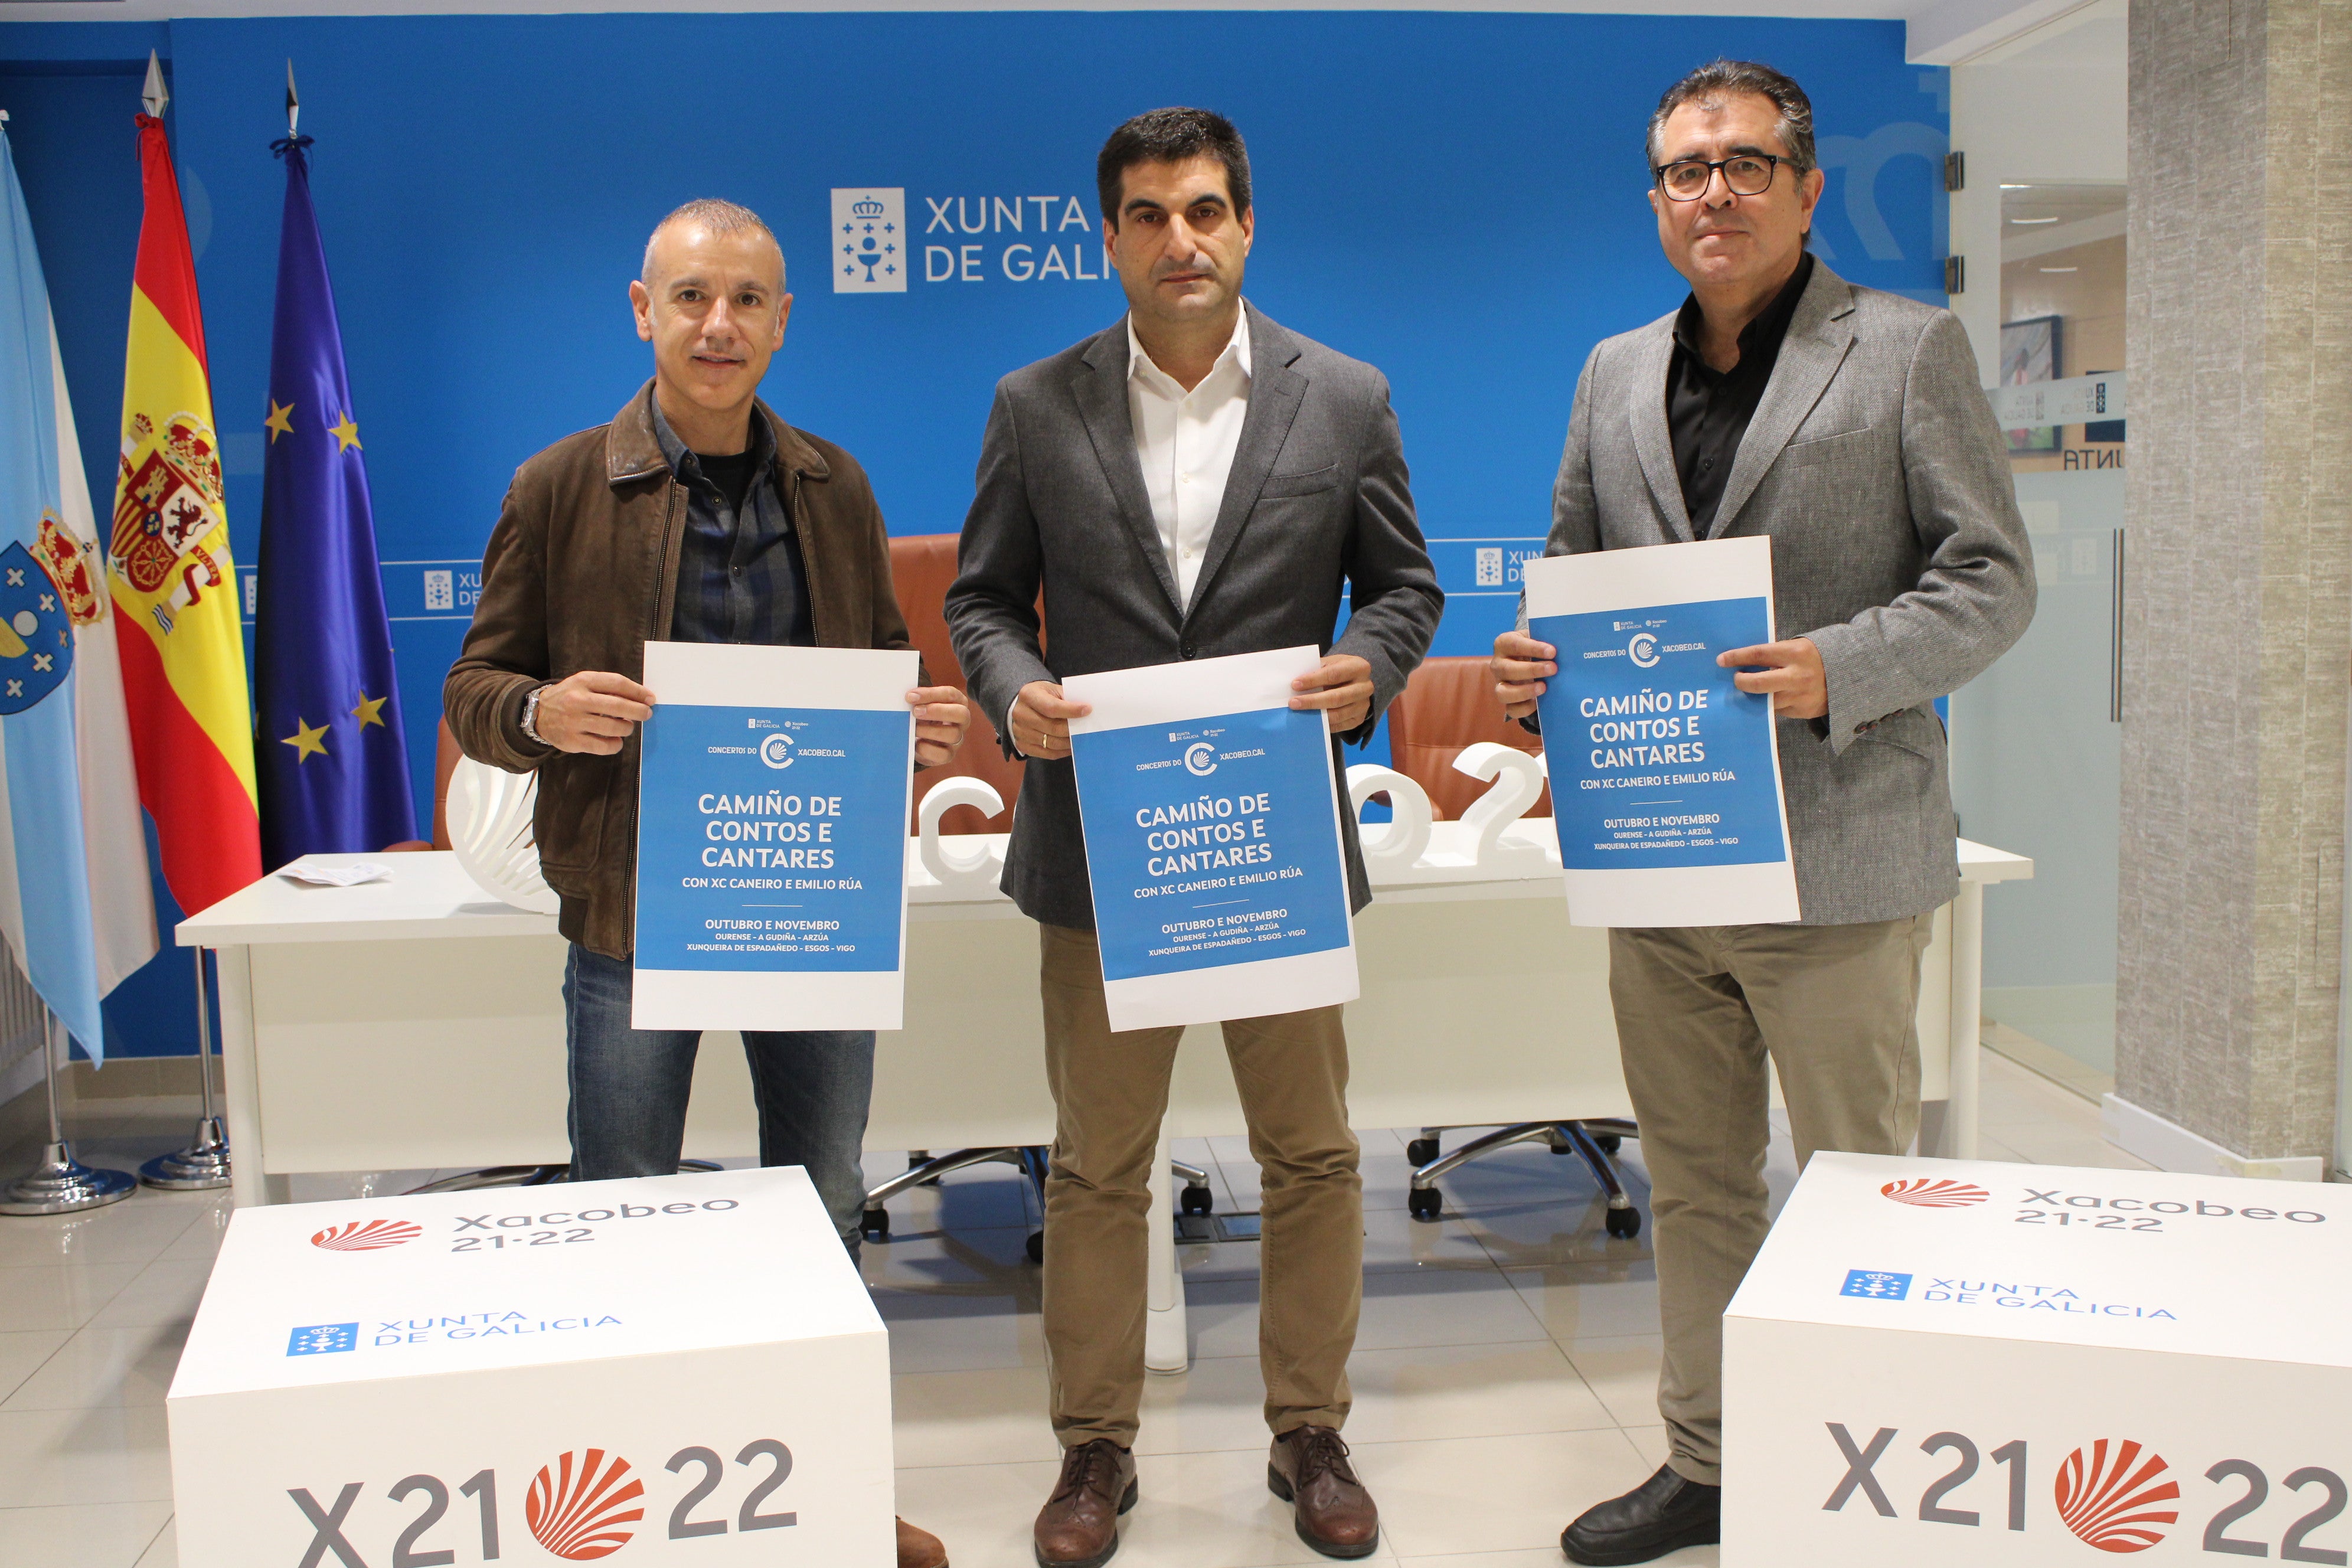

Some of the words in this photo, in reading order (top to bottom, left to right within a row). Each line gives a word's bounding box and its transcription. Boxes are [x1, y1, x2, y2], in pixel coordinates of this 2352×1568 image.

[926, 196, 1090, 234] XUNTA
[926, 245, 984, 282] DE
[1002, 244, 1110, 281] GALI
[1509, 551, 1543, 564] XUN
[1583, 649, 1616, 659] CONCERTOS
[1580, 688, 1672, 718] CAMIÑO
[1678, 689, 1709, 710] DE
[1590, 717, 1680, 743] CONTOS
[1687, 716, 1700, 736] E
[1136, 760, 1171, 771] CONCERTOS
[1590, 741, 1705, 769] CANTARES
[1580, 779, 1600, 790] CON
[1602, 779, 1615, 789] XC
[1616, 776, 1661, 788] CANEIRO
[1664, 775, 1670, 785] E
[1672, 772, 1710, 784] EMILIO
[1712, 768, 1736, 781] RÚA
[698, 790, 802, 816] CAMIÑO
[810, 796, 842, 816] DE
[1136, 795, 1232, 828] CAMIÑO
[1239, 793, 1270, 815] DE
[706, 821, 811, 842] CONTOS
[818, 823, 832, 842] E
[1604, 817, 1650, 828] OUTUBRO
[1653, 817, 1659, 827] E
[1661, 814, 1720, 826] NOVEMBRO
[1655, 828, 1682, 837] GUDIÑA
[1688, 827, 1711, 836] ARZÚA
[1147, 821, 1246, 851] CONTOS
[1252, 819, 1266, 838] E
[1641, 839, 1685, 848] ESPADAÑEDO
[702, 847, 834, 869] CANTARES
[1148, 843, 1272, 877] CANTARES
[682, 877, 708, 888] CON
[711, 878, 727, 888] XC
[730, 878, 782, 889] CANEIRO
[785, 880, 792, 889] E
[795, 880, 836, 890] EMILIO
[839, 877, 863, 890] RÚA
[1134, 886, 1158, 899] CON
[1161, 884, 1175, 895] XC
[1178, 878, 1227, 893] CANEIRO
[1230, 876, 1236, 886] E
[1239, 871, 1277, 885] EMILIO
[1280, 865, 1304, 879] RÚA
[705, 919, 763, 930] OUTUBRO
[766, 920, 772, 930] E
[775, 920, 839, 930] NOVEMBRO
[1162, 919, 1215, 934] OUTUBRO
[1217, 917, 1224, 926] E
[1226, 909, 1288, 925] NOVEMBRO
[1173, 933, 1207, 943] OURENSE
[1220, 926, 1249, 936] GUDIÑA
[1255, 922, 1279, 932] ARZÚA
[687, 944, 733, 952] XUNQUEIRA
[747, 943, 798, 952] ESPADAÑEDO
[766, 932, 796, 941] GUDIÑA
[803, 932, 829, 941] ARZÚA
[1149, 945, 1191, 956] XUNQUEIRA
[1204, 937, 1252, 949] ESPADAÑEDO
[1258, 932, 1282, 942] ESGOS
[1288, 929, 1306, 937] VIGO
[452, 1198, 740, 1232] Xacobeo
[2020, 1188, 2326, 1223] Xacobeo
[1929, 1278, 2080, 1299] XUNTA
[1923, 1291, 1978, 1304] DE
[1996, 1297, 2177, 1320] GALICIA
[374, 1330, 428, 1346] DE
[446, 1315, 623, 1340] GALICIA
[378, 1311, 528, 1332] XUNTA
[664, 1439, 798, 1540] 22
[2203, 1459, 2348, 1567] 22
